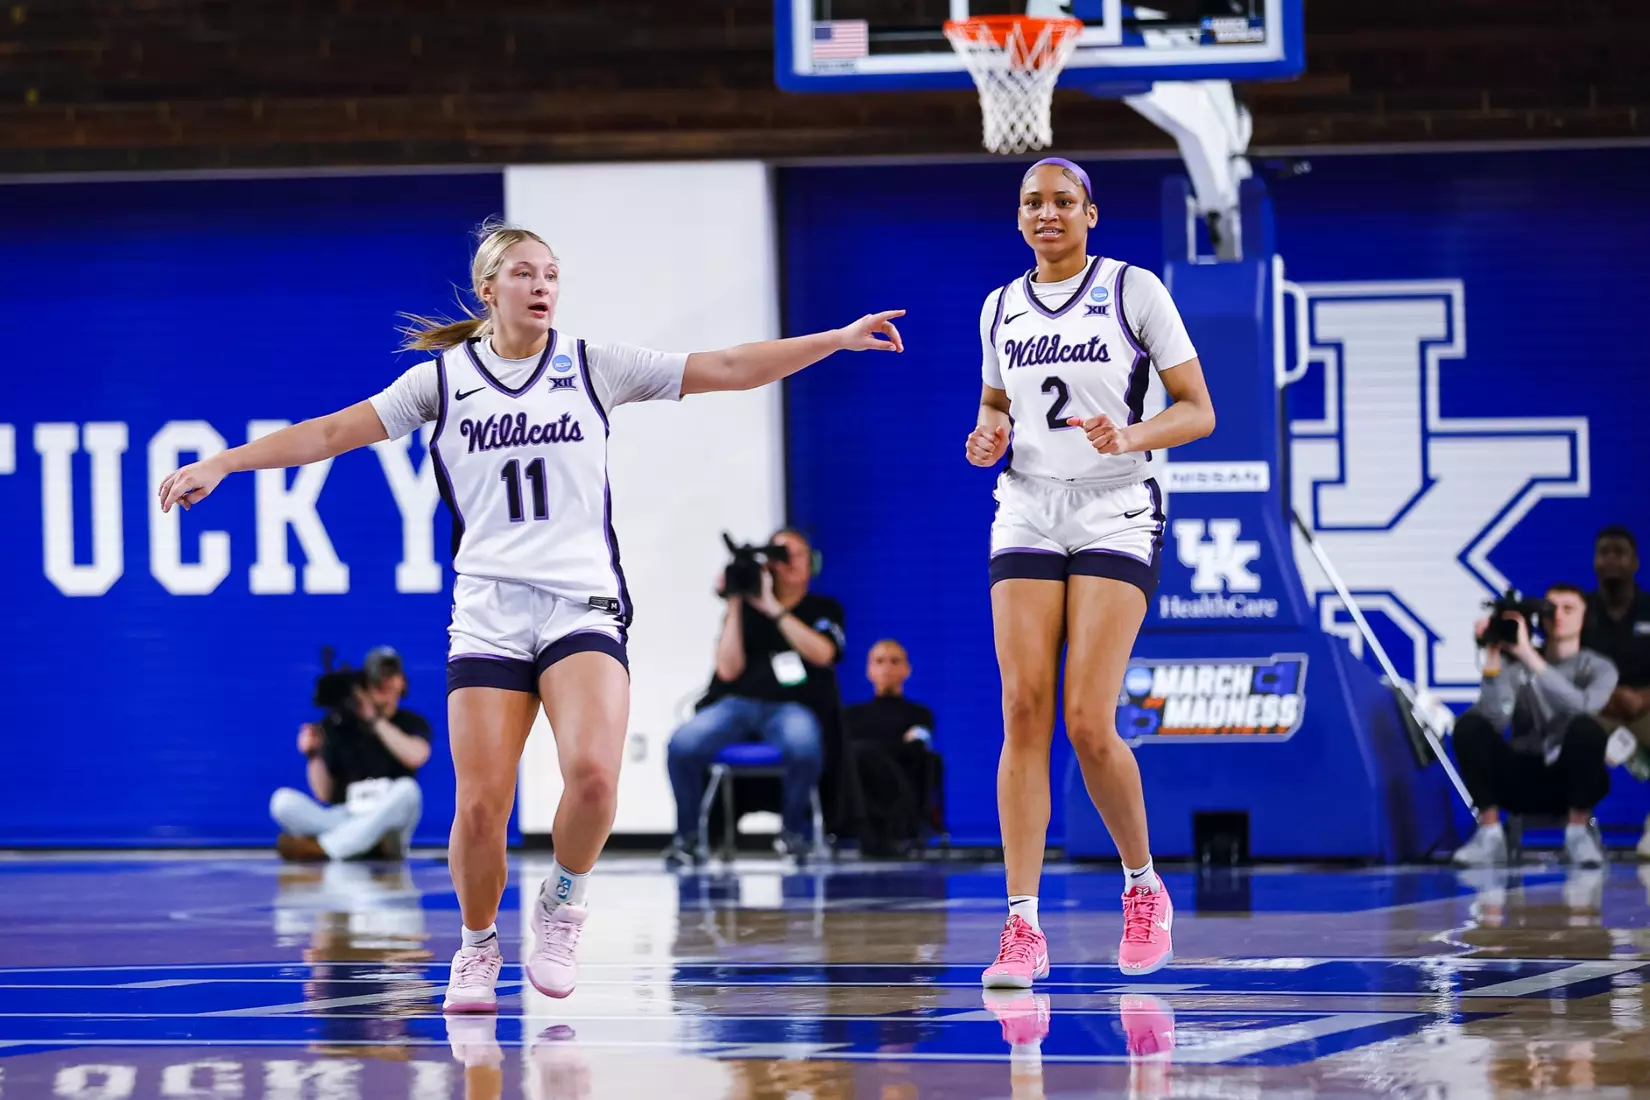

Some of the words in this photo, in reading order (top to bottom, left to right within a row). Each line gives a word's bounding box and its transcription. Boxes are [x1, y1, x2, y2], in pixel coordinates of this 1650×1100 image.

[1005, 334, 1111, 370] Wildcats
[1041, 376, 1075, 432] 2
[460, 411, 584, 454] Wildcats
[0, 419, 443, 597] UCKY
[501, 457, 549, 522] 11
[1172, 518, 1261, 593] UK
[1159, 594, 1279, 619] HealthCare
[1150, 664, 1254, 697] MARCH
[1162, 694, 1299, 728] MADNESS
